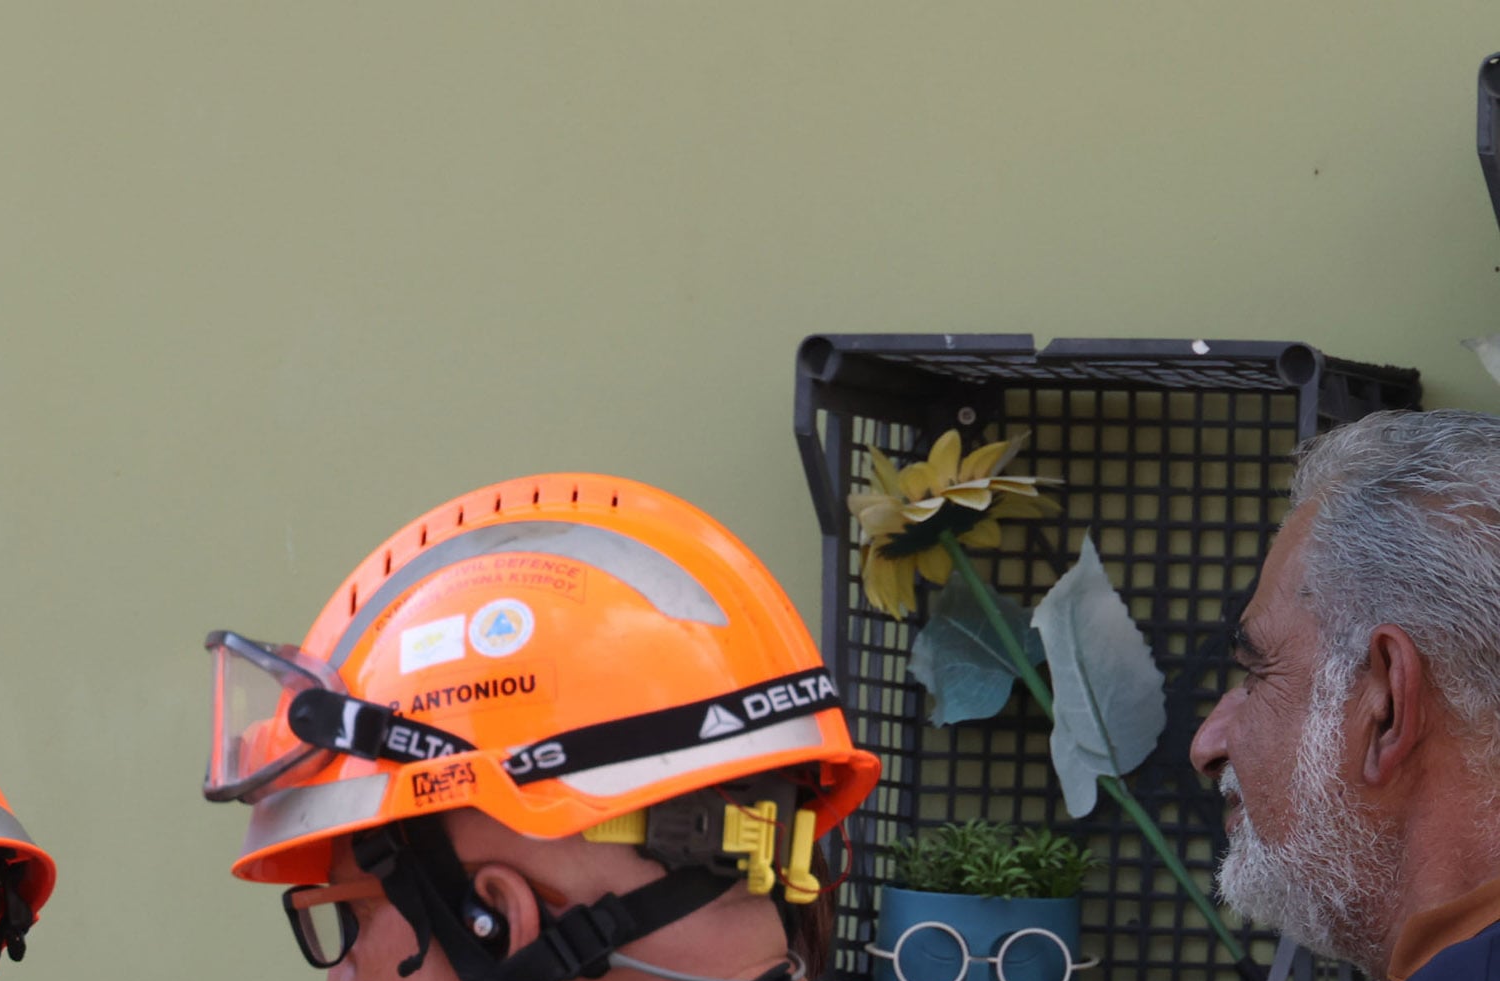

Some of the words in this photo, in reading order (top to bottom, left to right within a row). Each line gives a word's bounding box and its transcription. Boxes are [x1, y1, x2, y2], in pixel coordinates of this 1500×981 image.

[493, 557, 581, 579] DEFENCE
[410, 674, 537, 714] ANTONIOU
[742, 674, 840, 721] DELTA
